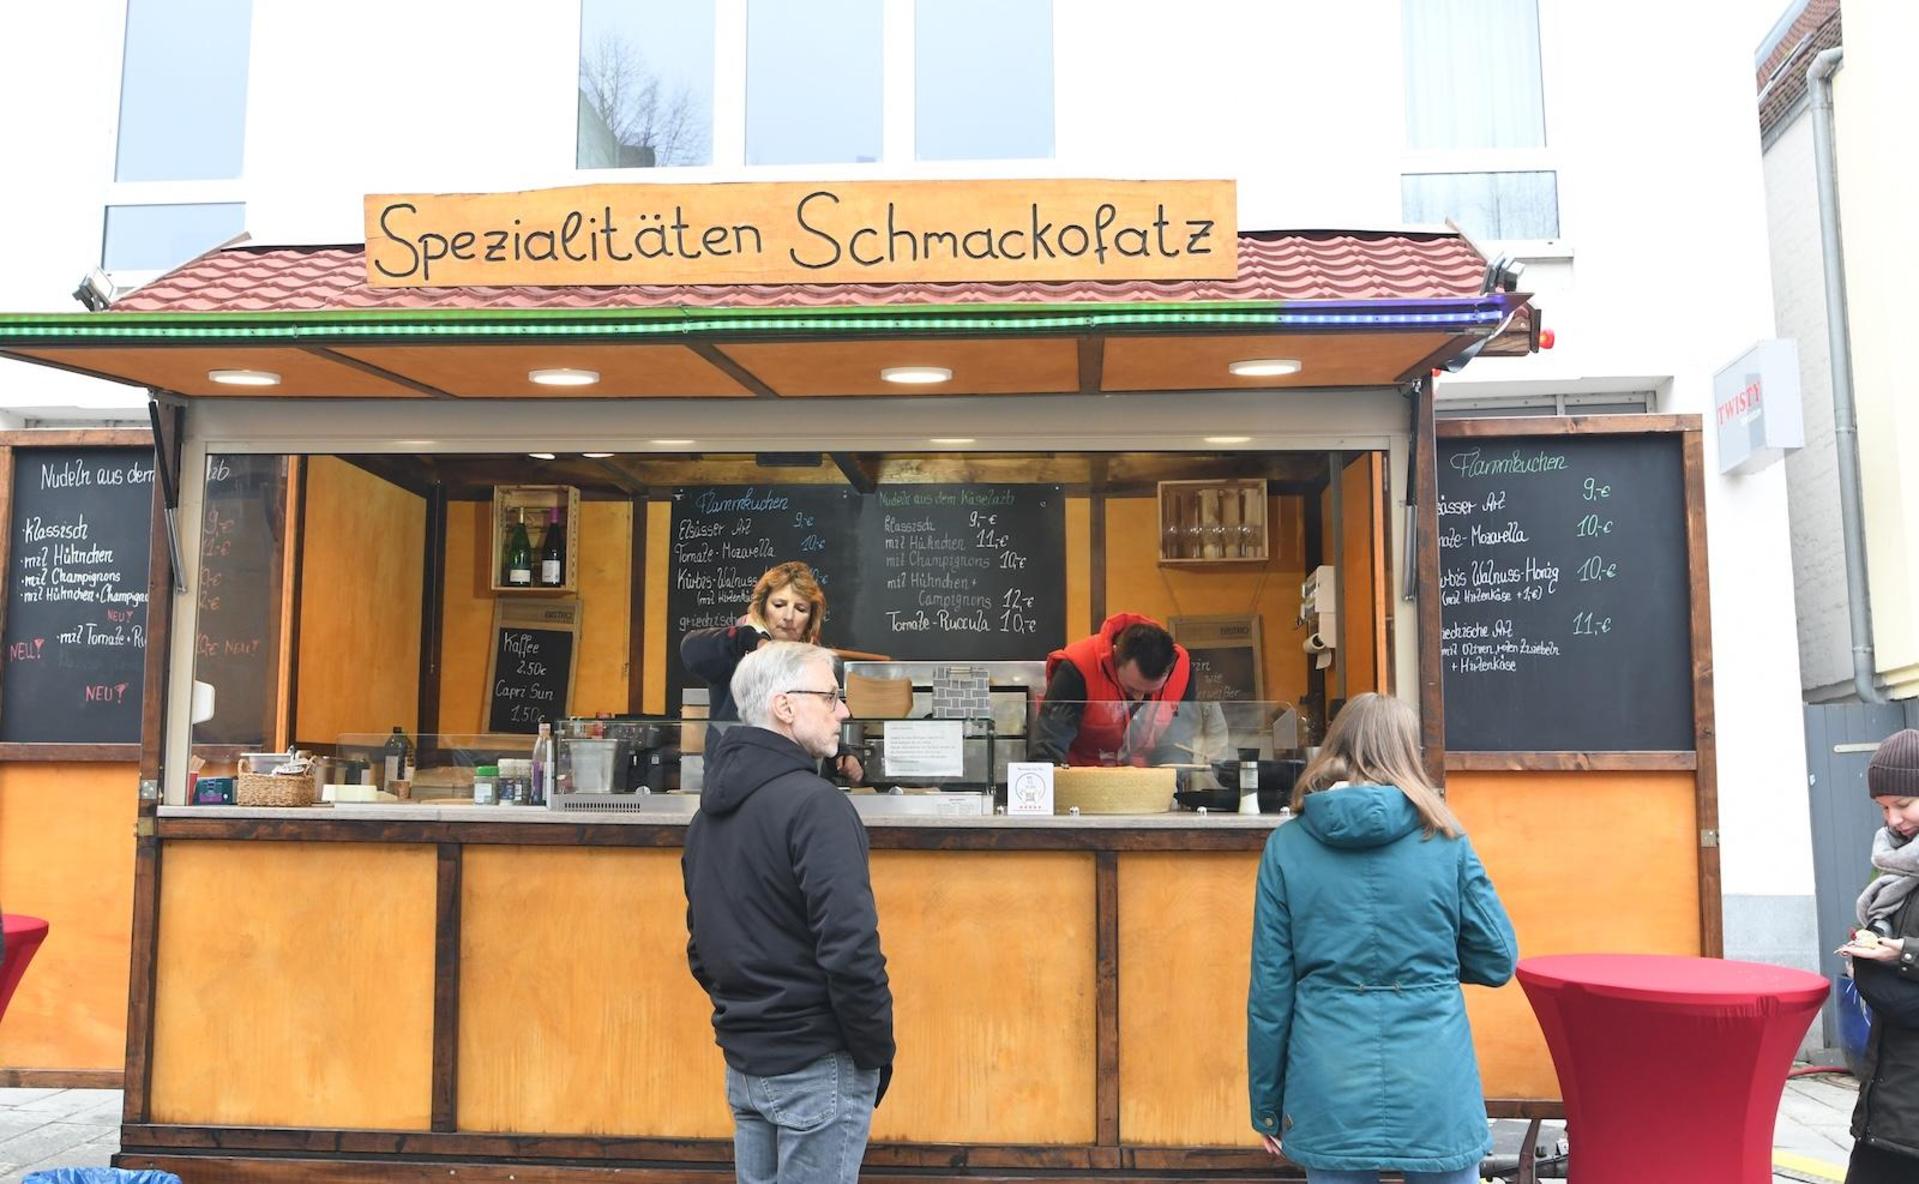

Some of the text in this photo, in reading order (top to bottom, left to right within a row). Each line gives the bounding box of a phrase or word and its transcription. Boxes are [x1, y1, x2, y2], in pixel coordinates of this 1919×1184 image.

[374, 191, 1215, 281] Spezialitäten Schmackofatz
[1449, 447, 1570, 478] Flammkuchen
[41, 458, 91, 490] Nudeln
[97, 468, 123, 485] aus
[696, 487, 789, 514] Flammkuchen
[1482, 491, 1506, 512] Art
[885, 535, 905, 550] mit
[24, 547, 48, 568] mit
[54, 543, 114, 566] Hühnchen
[886, 553, 905, 568] mit
[24, 568, 47, 588] mit
[51, 568, 121, 588] Champignons
[887, 571, 907, 589] mit
[24, 585, 43, 603] mit
[100, 584, 149, 607] Champigno
[679, 611, 738, 632] griechisch
[60, 625, 83, 645] mit
[503, 632, 540, 659] Kaffee
[496, 679, 554, 701] Capri Sun
